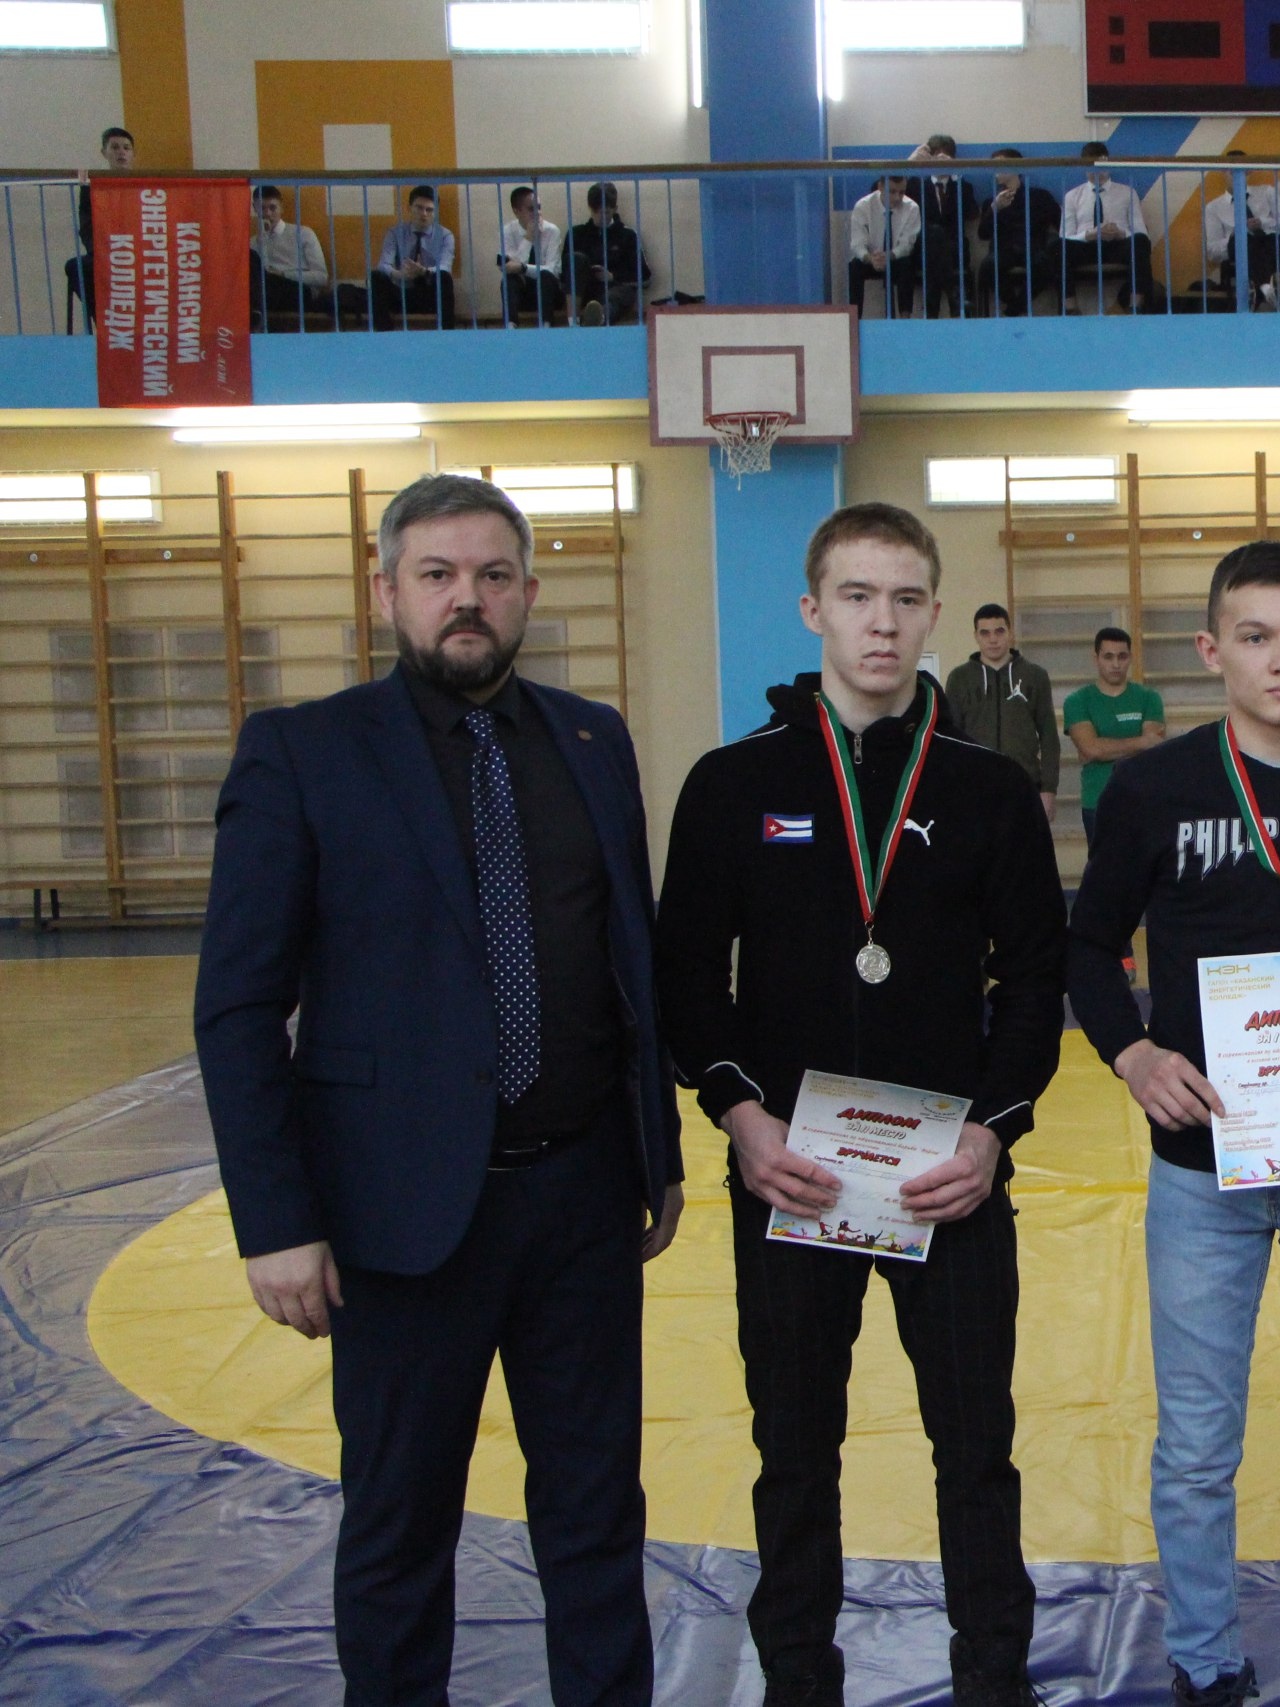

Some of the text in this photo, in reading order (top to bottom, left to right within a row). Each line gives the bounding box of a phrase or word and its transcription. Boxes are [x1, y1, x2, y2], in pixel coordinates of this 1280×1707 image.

[105, 234, 136, 352] КОЛЛЕДЖ
[140, 189, 173, 396] ЭНЕРГЕТИЧЕСКИЙ
[176, 222, 206, 363] КАЗАНСКИЙ
[217, 326, 234, 349] 60
[1257, 1032, 1271, 1044] ЗА
[836, 1107, 922, 1130] ДИПЛОМ
[869, 1126, 907, 1140] МЕСТО
[836, 1146, 902, 1166] ВРУЧАЕТСЯ
